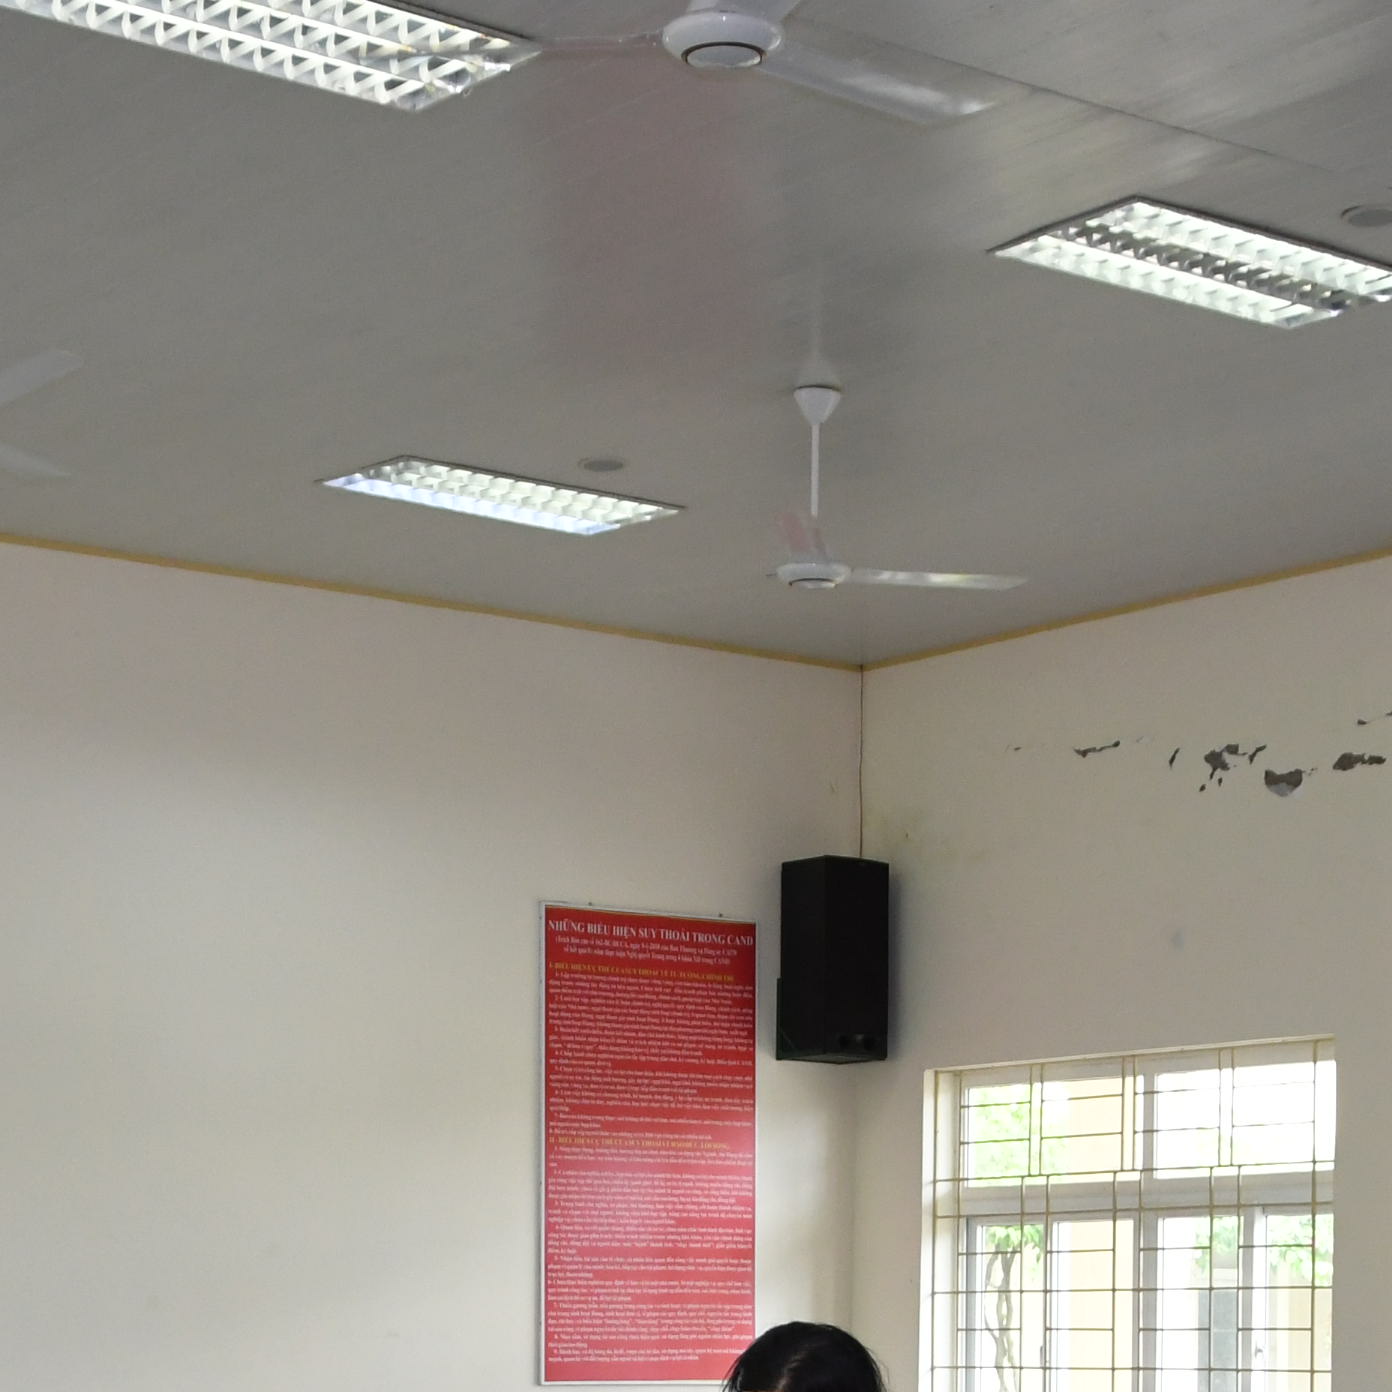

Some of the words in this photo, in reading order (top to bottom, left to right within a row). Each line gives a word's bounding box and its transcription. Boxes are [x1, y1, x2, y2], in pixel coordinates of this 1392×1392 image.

[638, 927, 657, 938] SUY
[692, 932, 726, 945] TRONG
[727, 935, 753, 946] CAND
